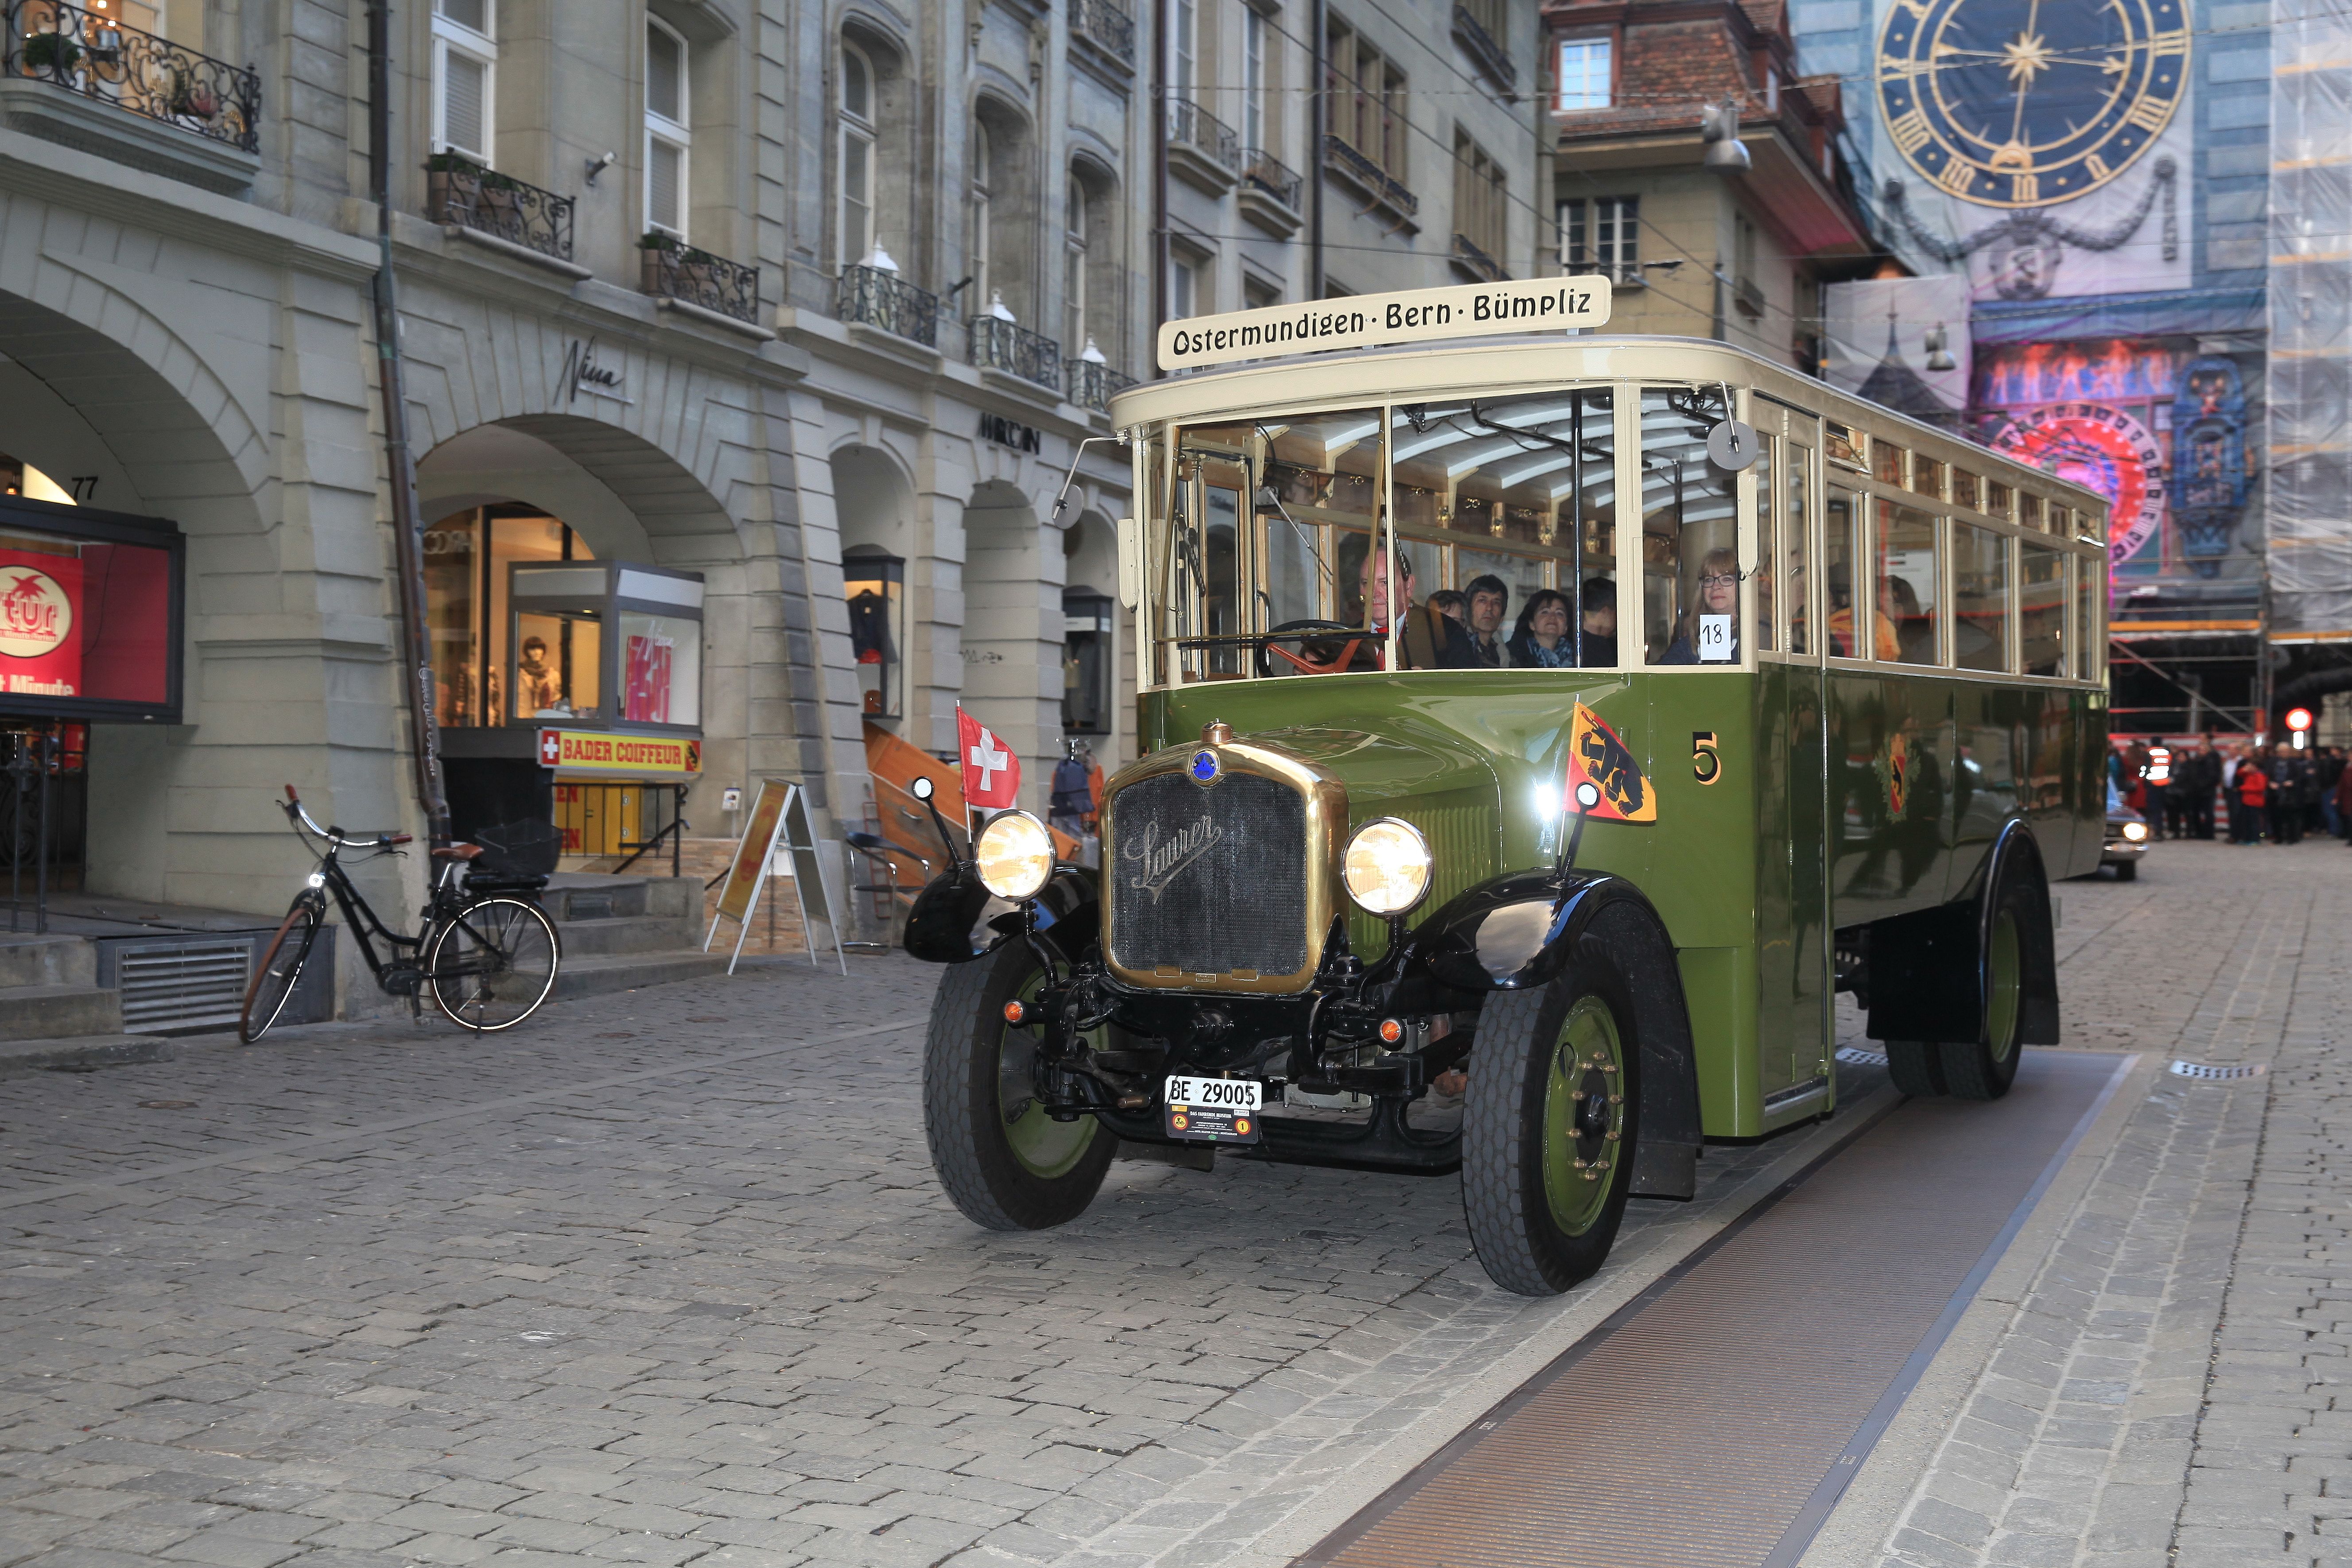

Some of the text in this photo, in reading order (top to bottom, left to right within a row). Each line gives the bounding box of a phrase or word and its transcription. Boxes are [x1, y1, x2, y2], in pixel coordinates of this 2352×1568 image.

[1173, 288, 1591, 355] Ostermundigen Bern Bümpliz
[553, 335, 625, 405] Nina
[71, 476, 98, 500] 77
[2, 592, 58, 634] tur
[1702, 624, 1722, 645] 18
[563, 738, 682, 765] BADER COIFFEUR
[1692, 731, 1722, 786] 5
[1125, 814, 1221, 900] Saurer
[1171, 1080, 1255, 1106] BE 29005
